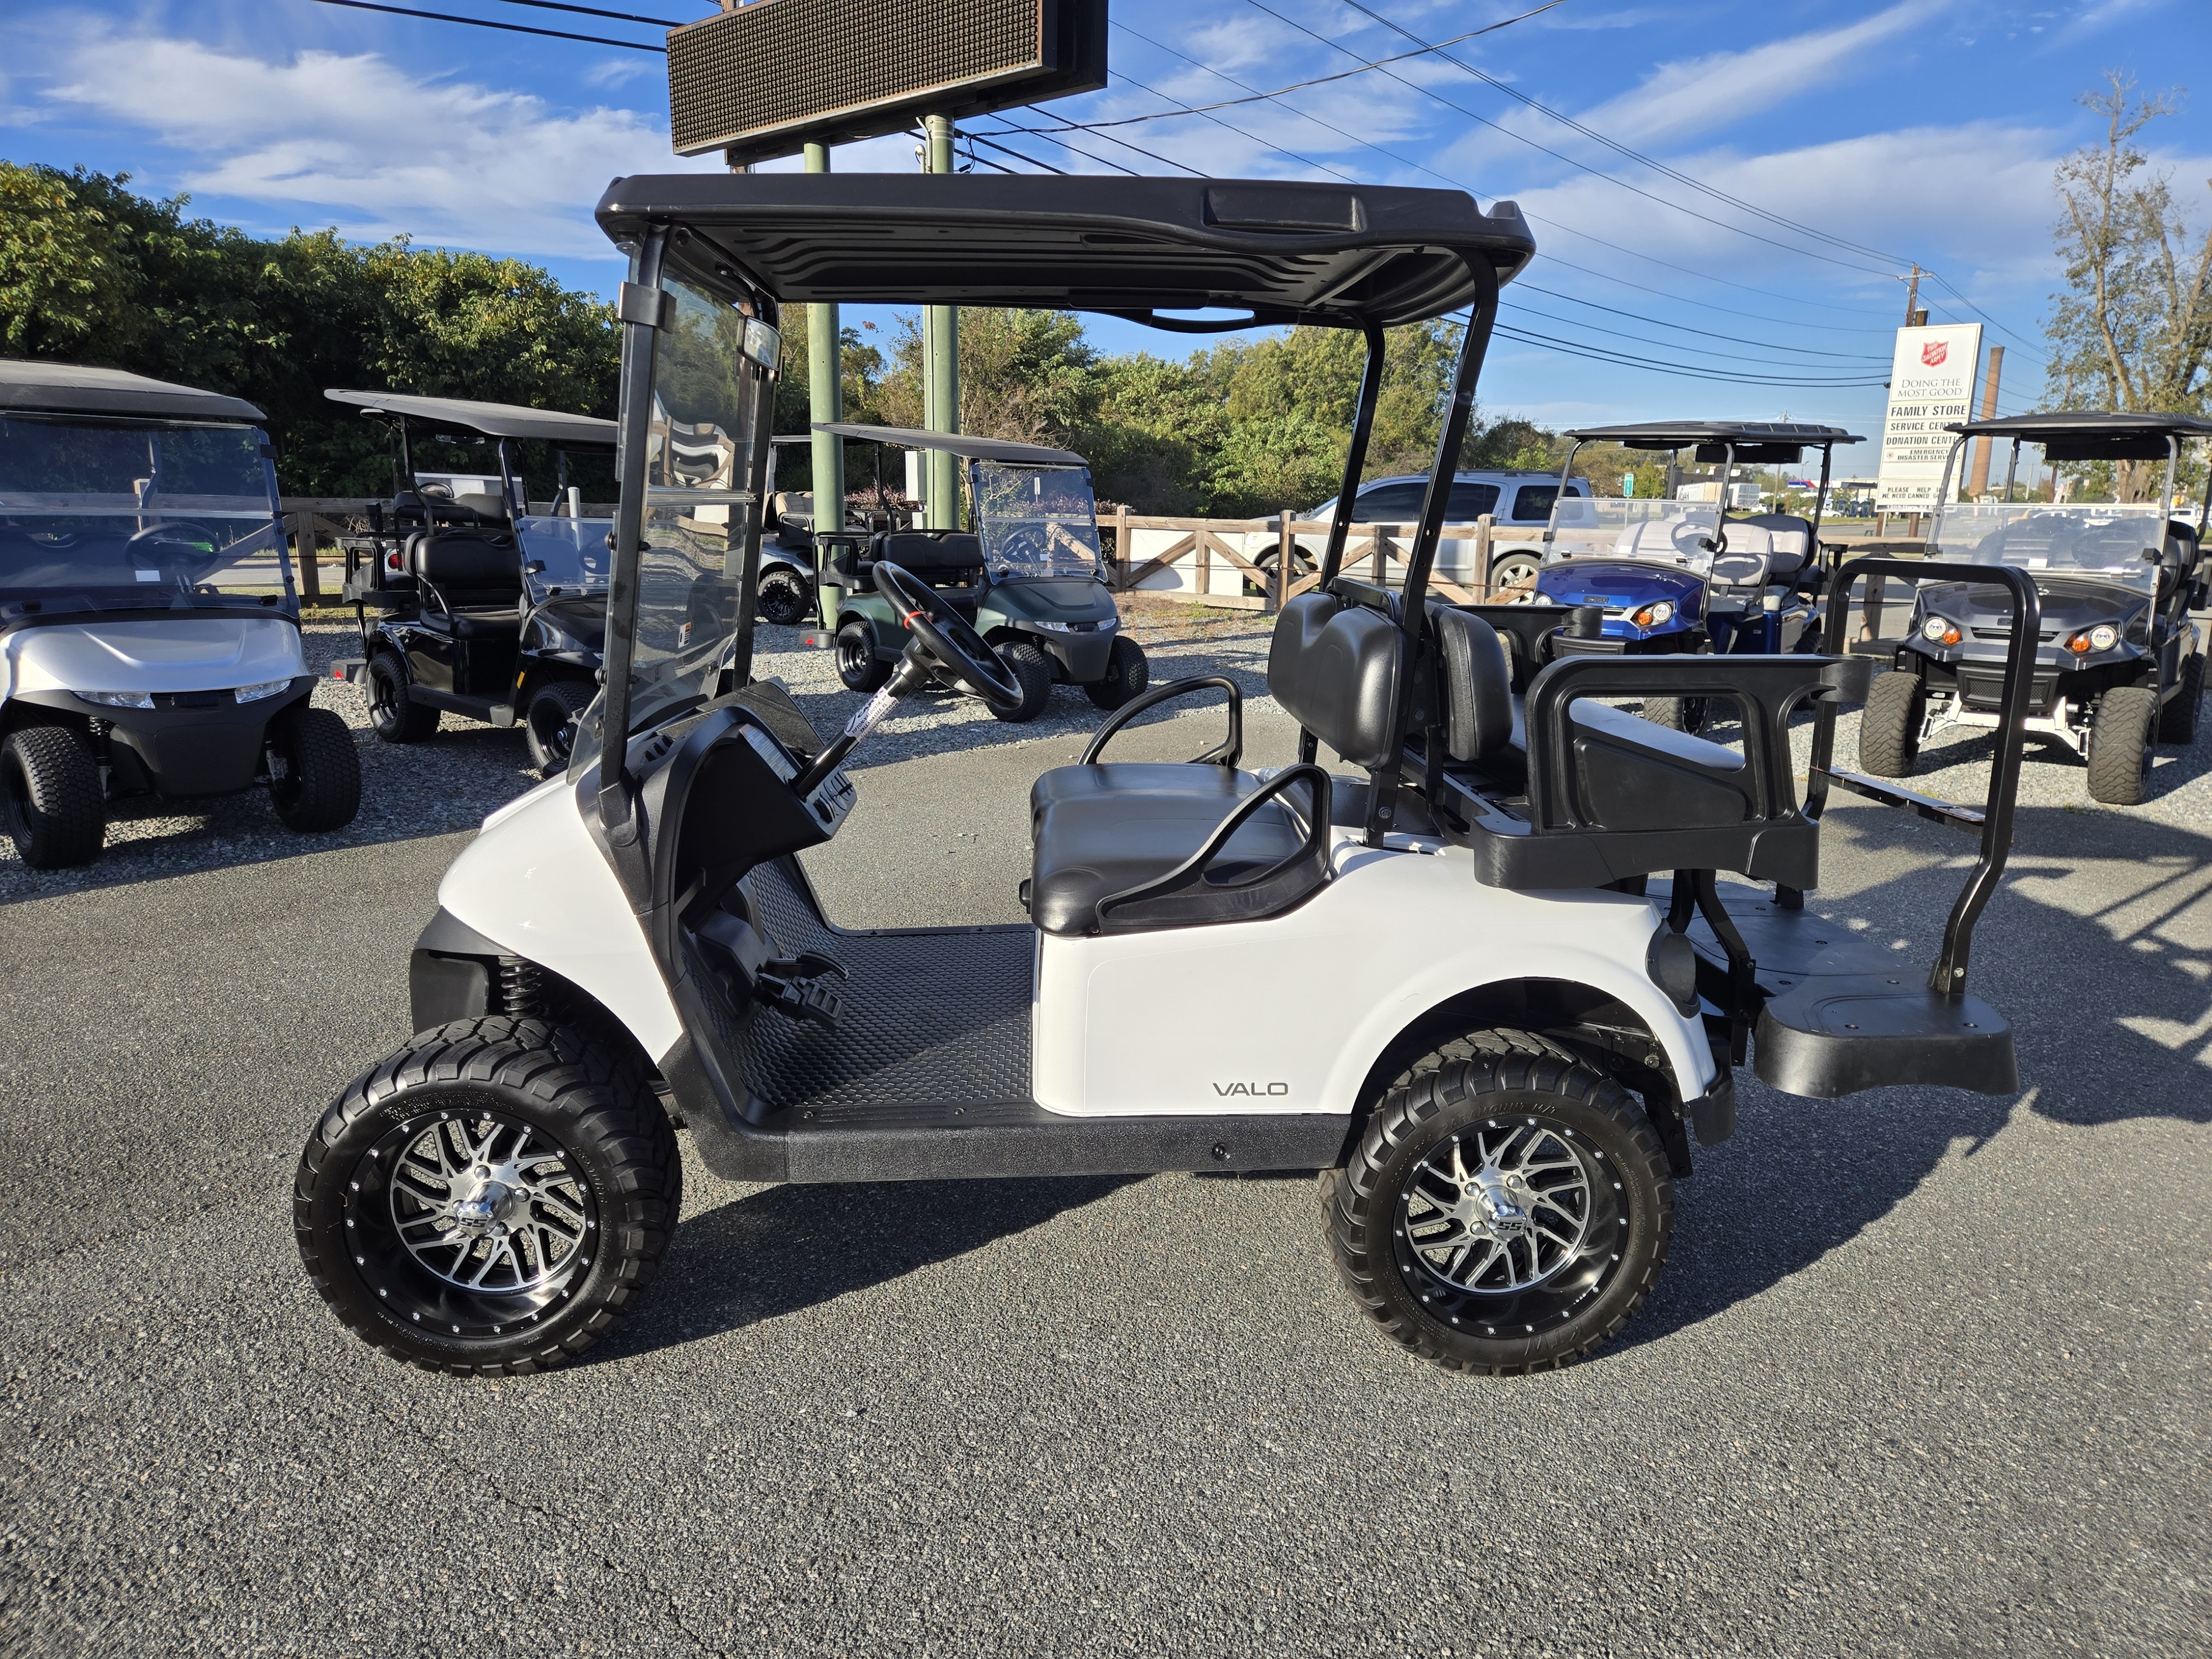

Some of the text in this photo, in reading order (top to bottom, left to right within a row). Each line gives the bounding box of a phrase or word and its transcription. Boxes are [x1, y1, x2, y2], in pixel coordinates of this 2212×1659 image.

[1902, 378, 1960, 388] DOING THE
[1898, 388, 1962, 397] MOST GOOD
[1891, 405, 1966, 416] FAMILY STORE
[1890, 422, 1962, 431] SERVICE CEN
[1886, 436, 1958, 445] DONATION CENTE
[1213, 1082, 1288, 1097] VALO
[459, 1217, 488, 1227] SS
[1497, 1221, 1523, 1231] SS
